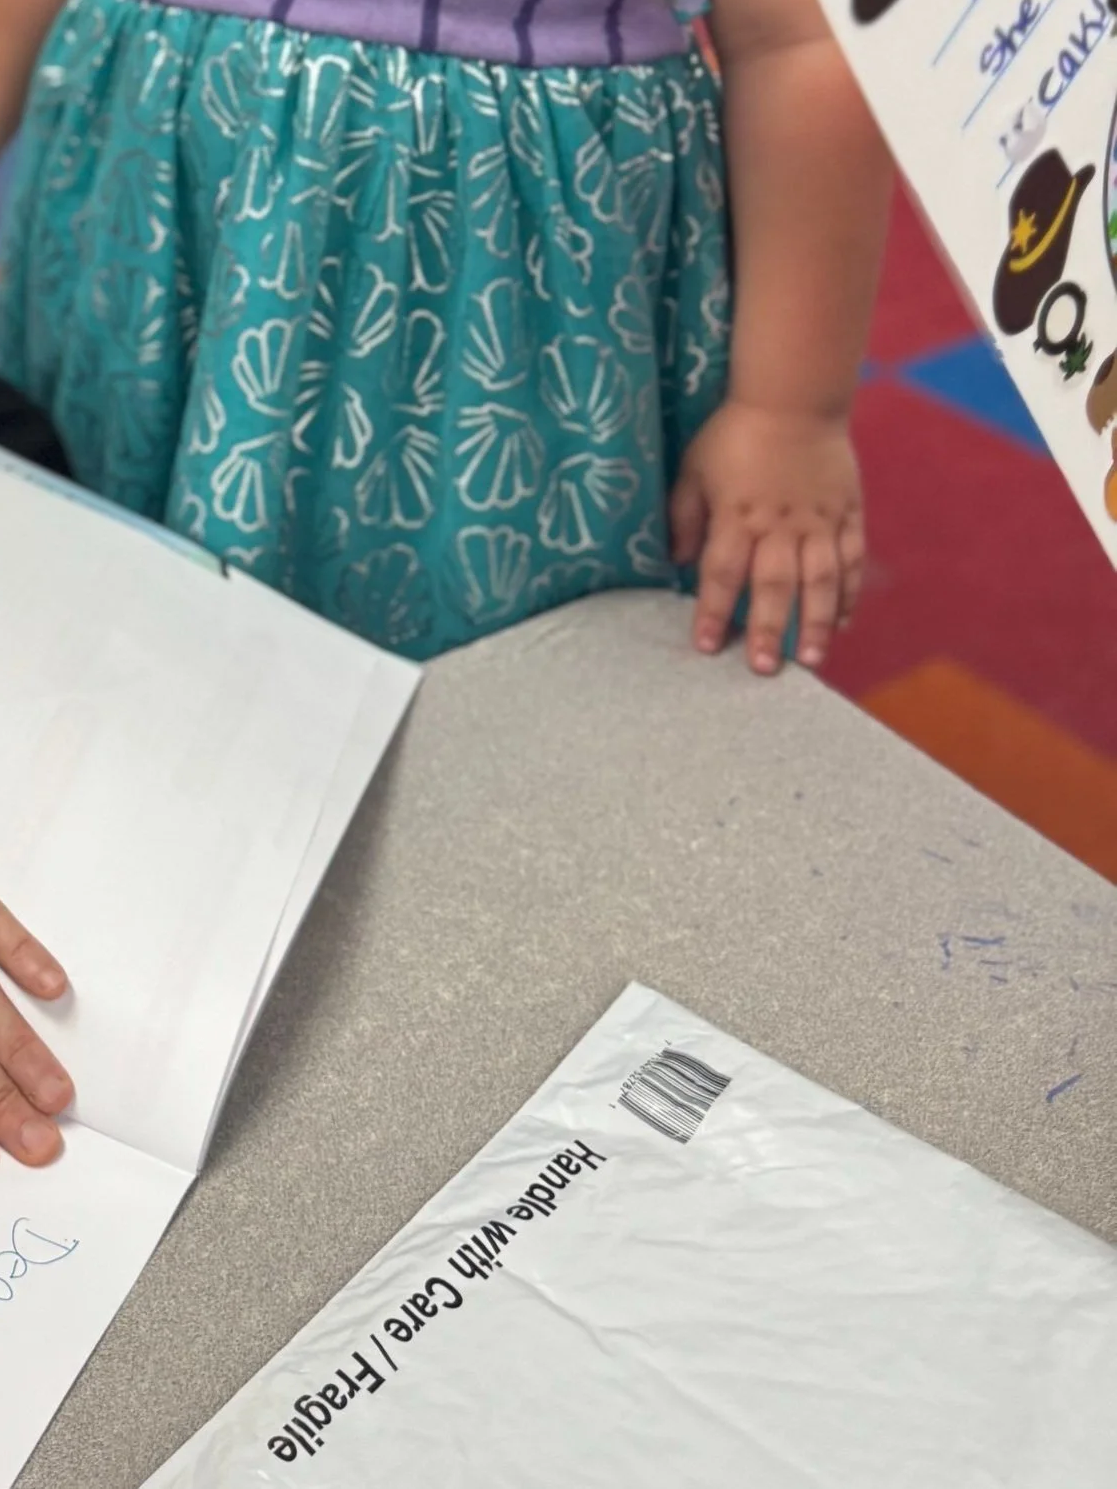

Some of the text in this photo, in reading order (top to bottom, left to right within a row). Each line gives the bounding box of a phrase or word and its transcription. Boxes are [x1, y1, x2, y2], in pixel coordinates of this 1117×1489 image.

[267, 1139, 608, 1462] Handle with Care / Fragile
